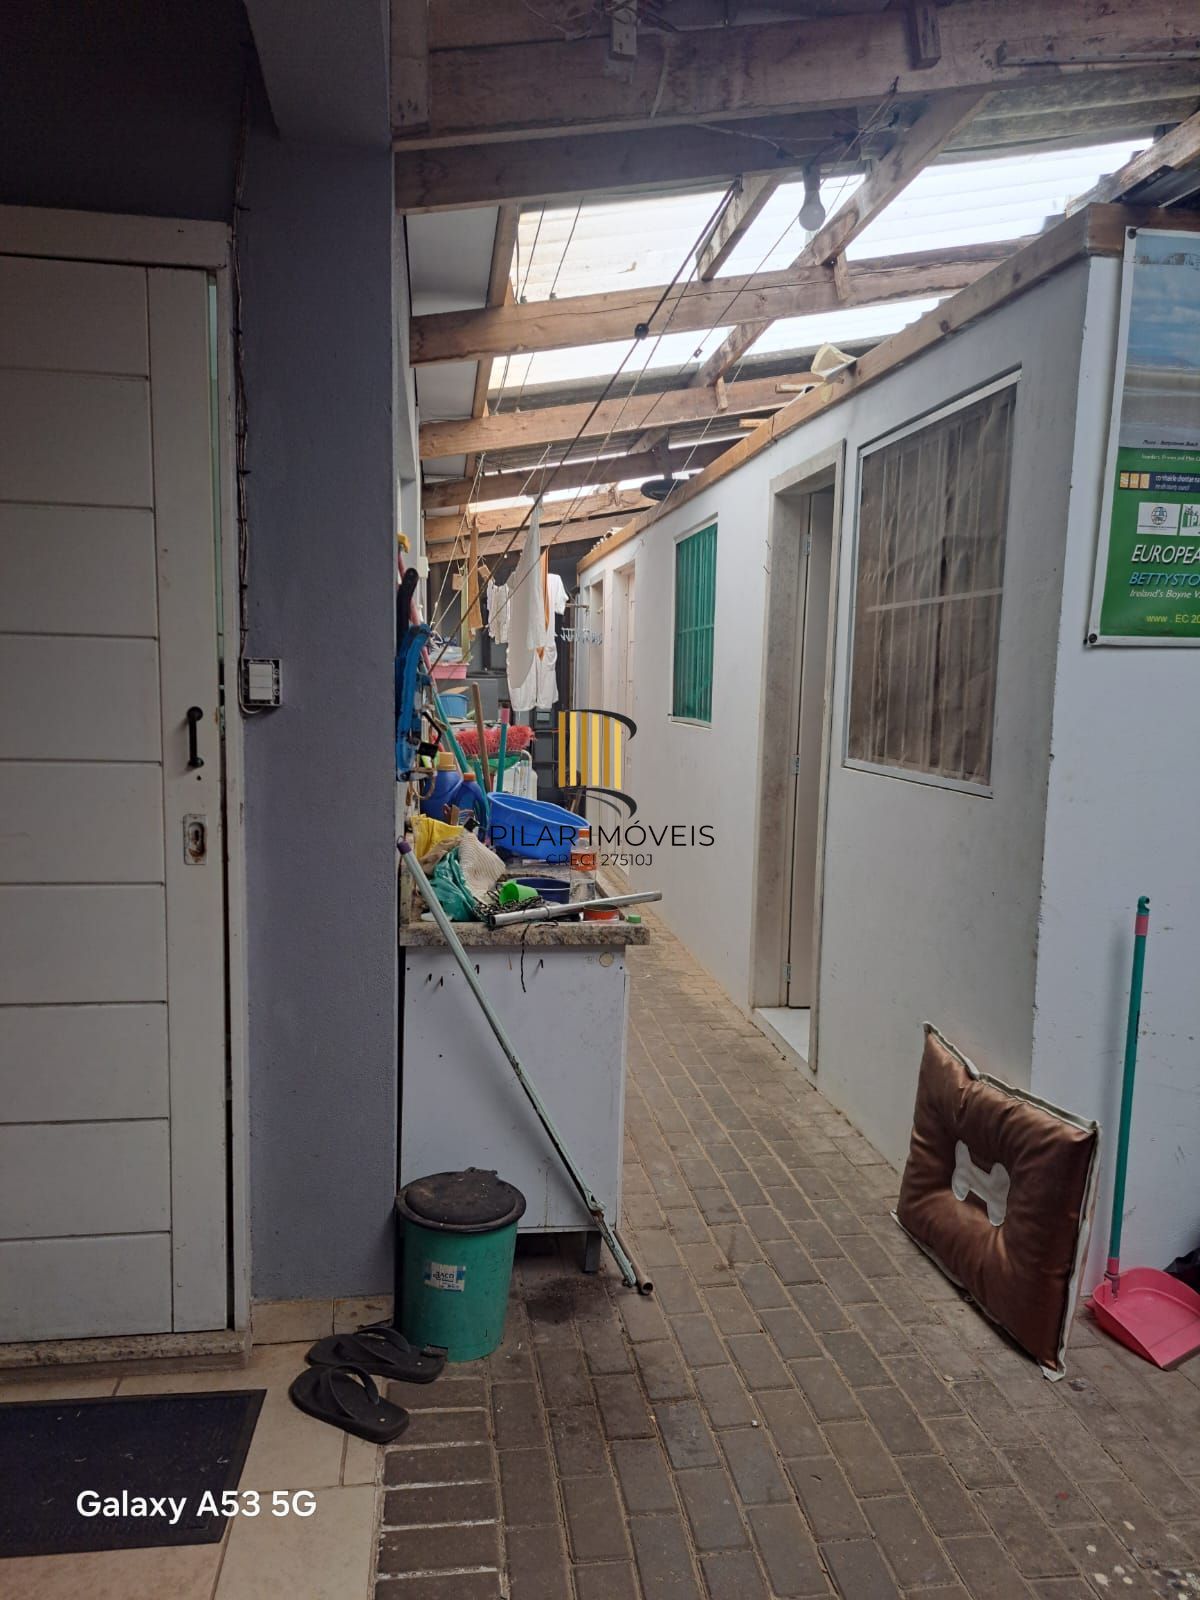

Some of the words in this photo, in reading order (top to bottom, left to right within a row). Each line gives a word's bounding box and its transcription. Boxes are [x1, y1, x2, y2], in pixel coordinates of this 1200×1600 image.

[1129, 571, 1200, 586] BETTYSTO
[1130, 589, 1164, 598] Ireland's
[1166, 590, 1192, 600] Boyne
[1175, 614, 1189, 623] EC
